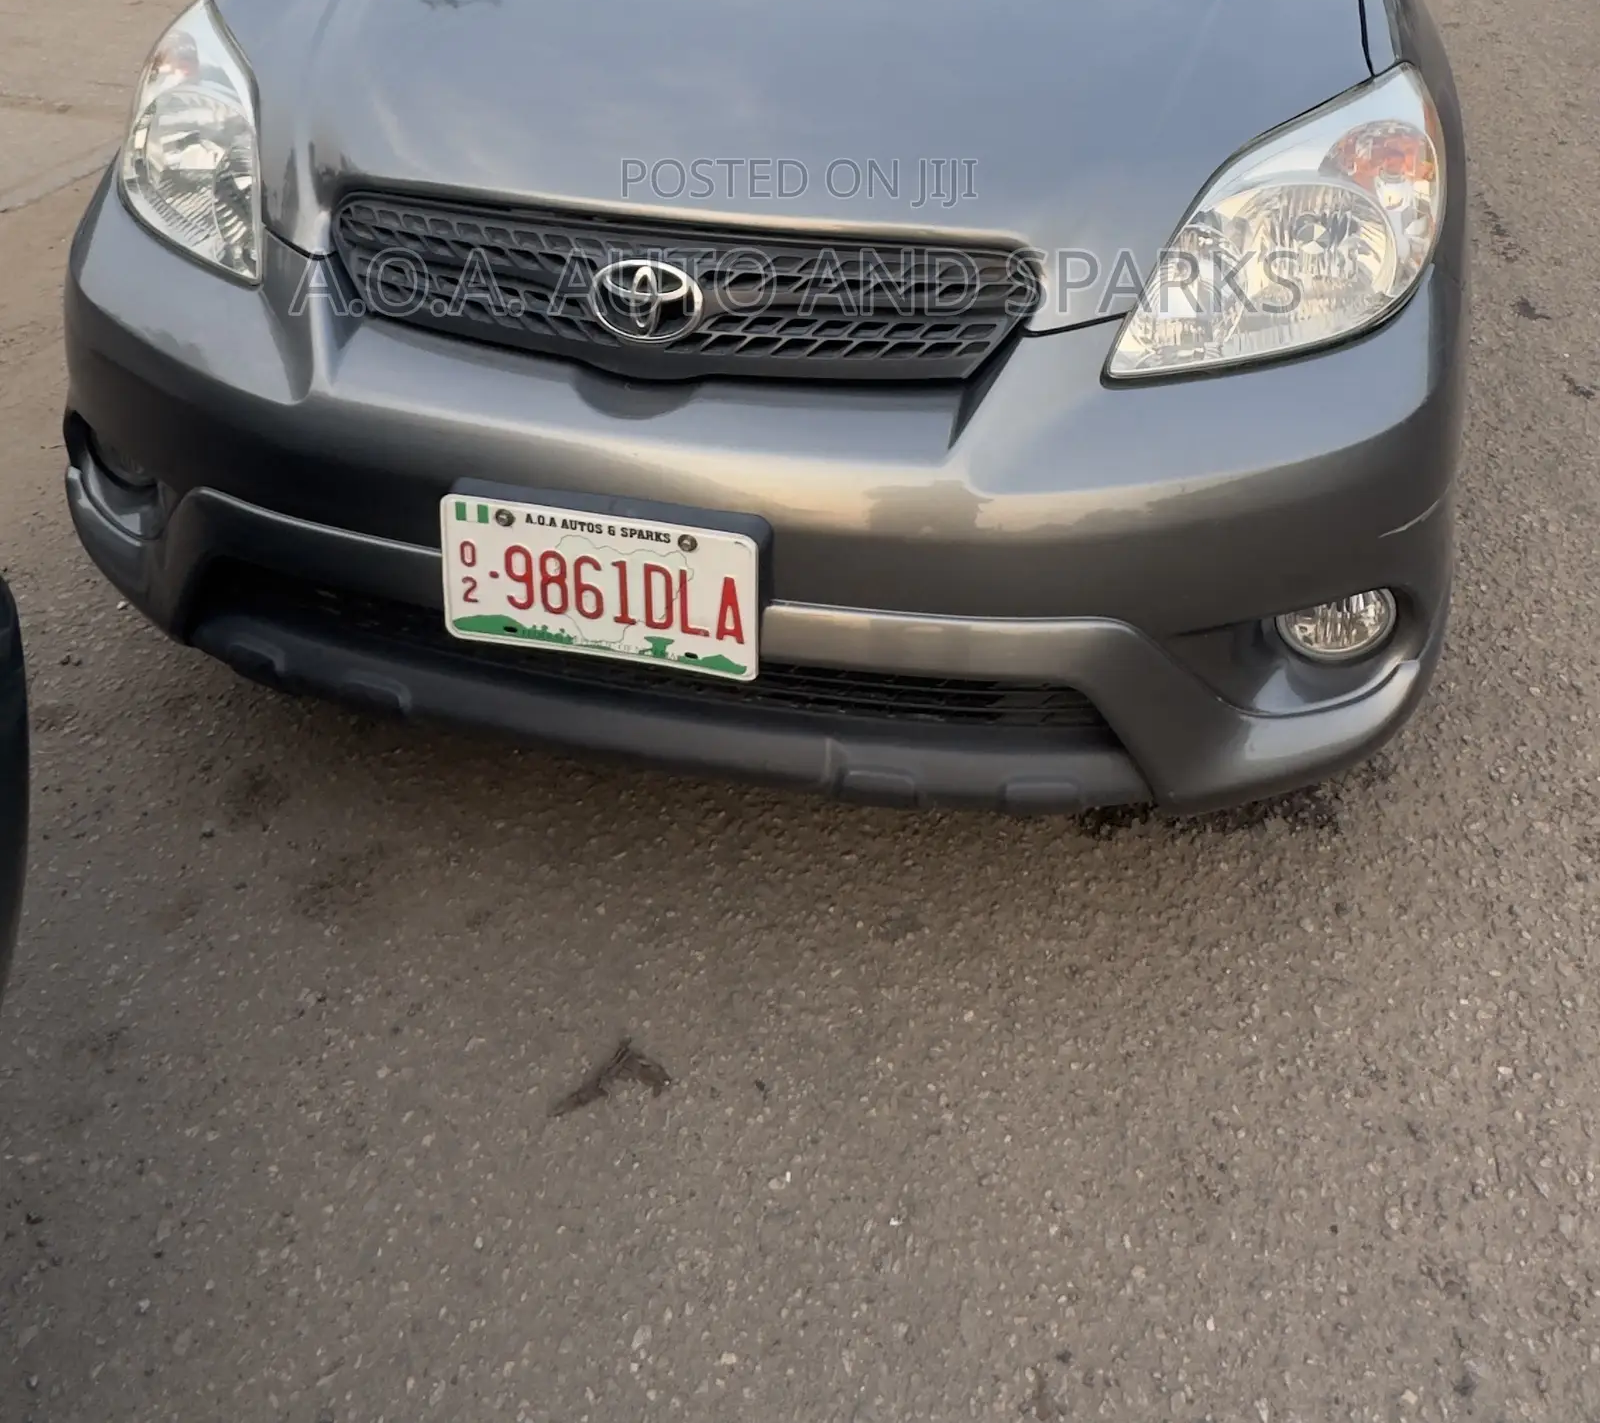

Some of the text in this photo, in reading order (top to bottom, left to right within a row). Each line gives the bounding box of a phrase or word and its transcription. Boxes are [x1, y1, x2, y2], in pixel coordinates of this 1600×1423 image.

[561, 518, 603, 534] AUTOS
[607, 525, 616, 536] &
[620, 527, 671, 544] SPARKS
